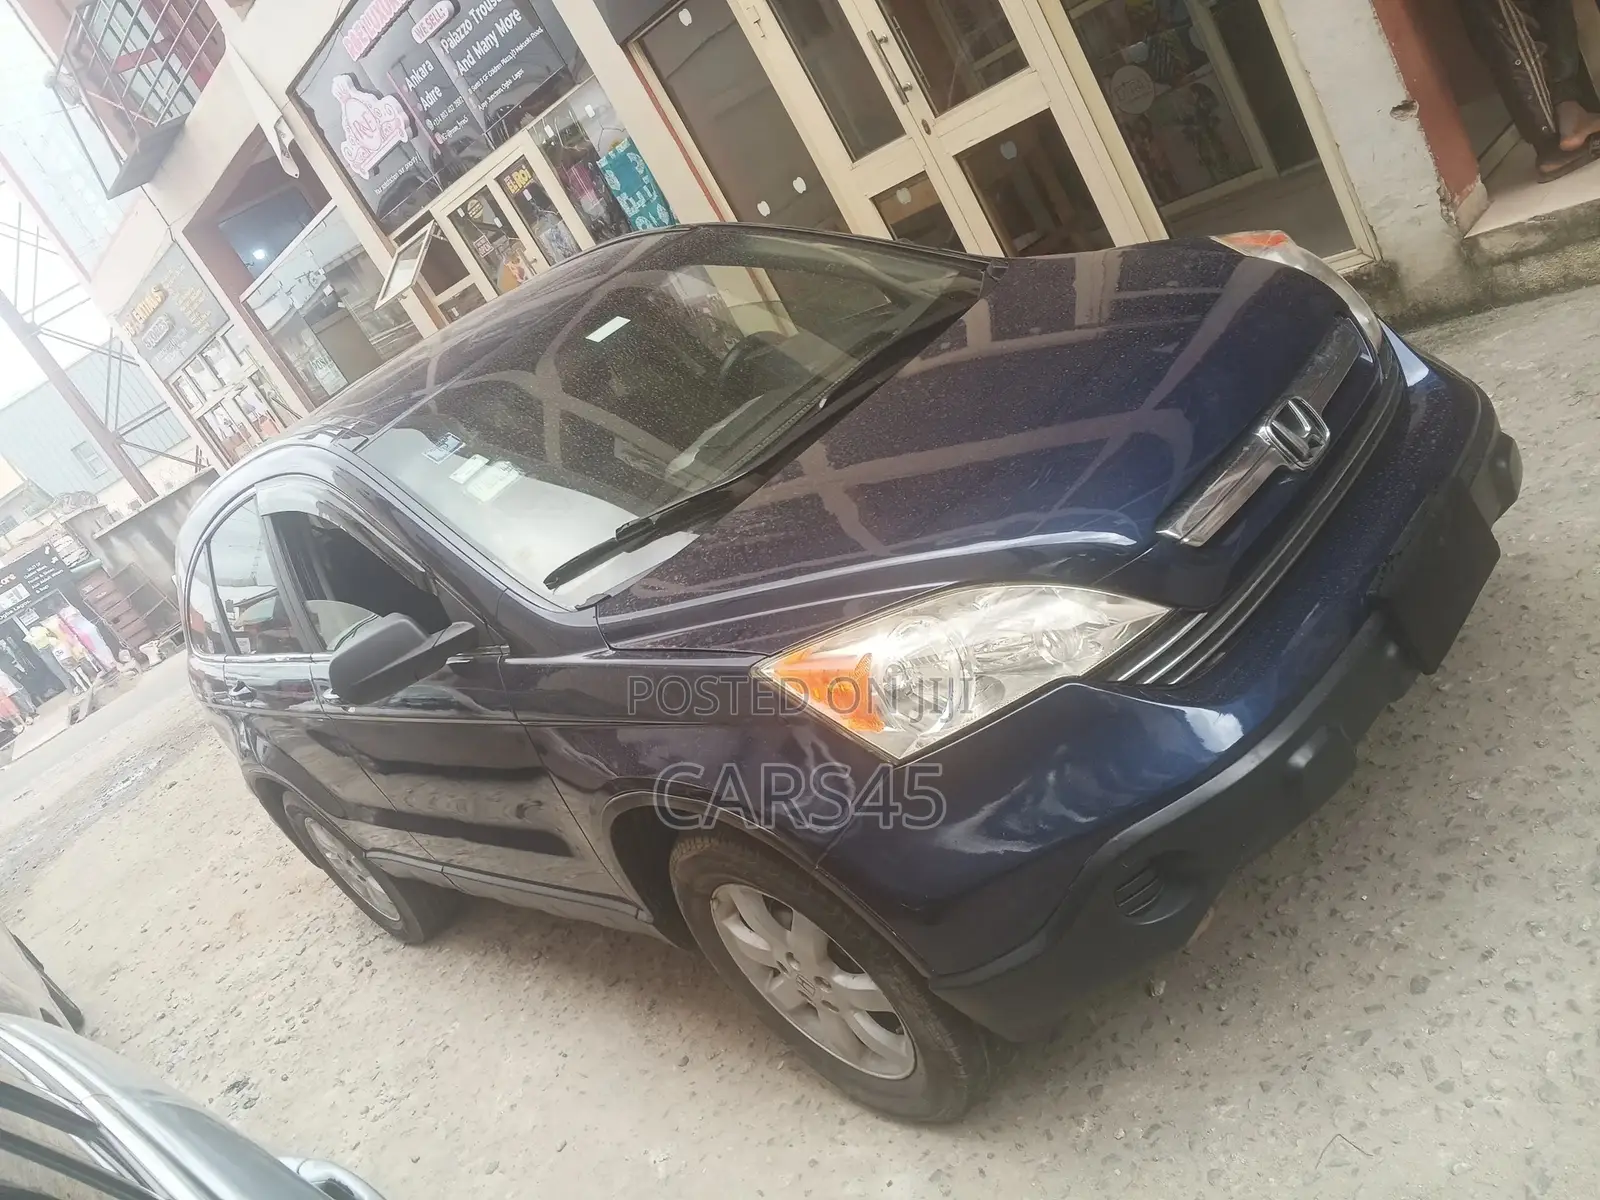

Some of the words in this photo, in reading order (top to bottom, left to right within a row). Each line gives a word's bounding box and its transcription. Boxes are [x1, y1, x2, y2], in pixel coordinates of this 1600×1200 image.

[415, 21, 429, 39] WE
[440, 18, 473, 53] Palazzo
[468, 0, 501, 25] Trous
[455, 49, 477, 76] And
[471, 28, 500, 60] Many
[494, 7, 523, 38] More
[404, 59, 435, 92] Ankara
[419, 85, 443, 111] Adire
